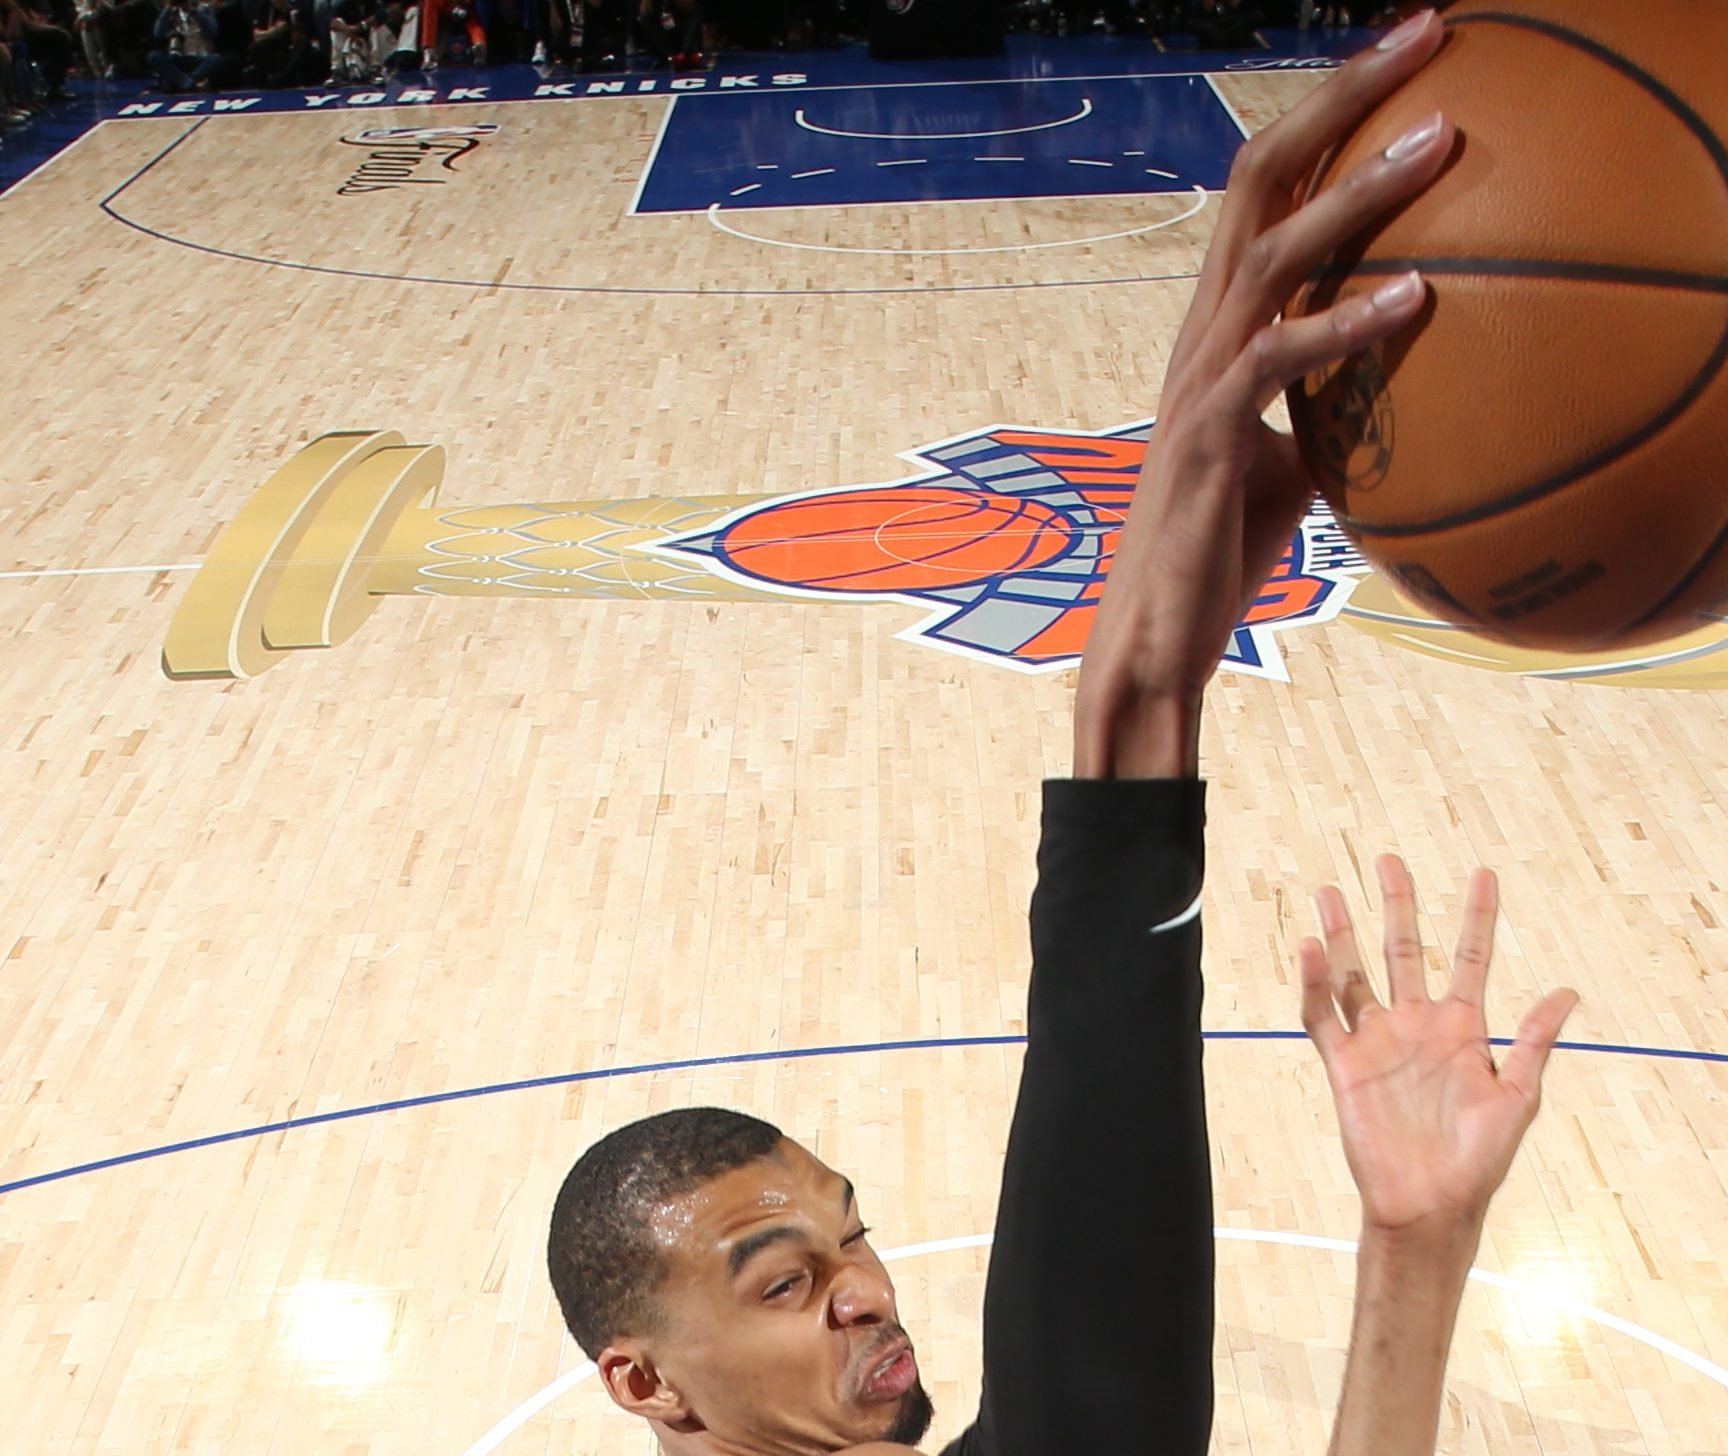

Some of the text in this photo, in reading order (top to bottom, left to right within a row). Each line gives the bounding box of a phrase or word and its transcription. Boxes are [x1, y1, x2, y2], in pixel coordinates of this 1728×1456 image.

[117, 74, 807, 116] NEW YORK KNICKS
[338, 136, 480, 197] Finals
